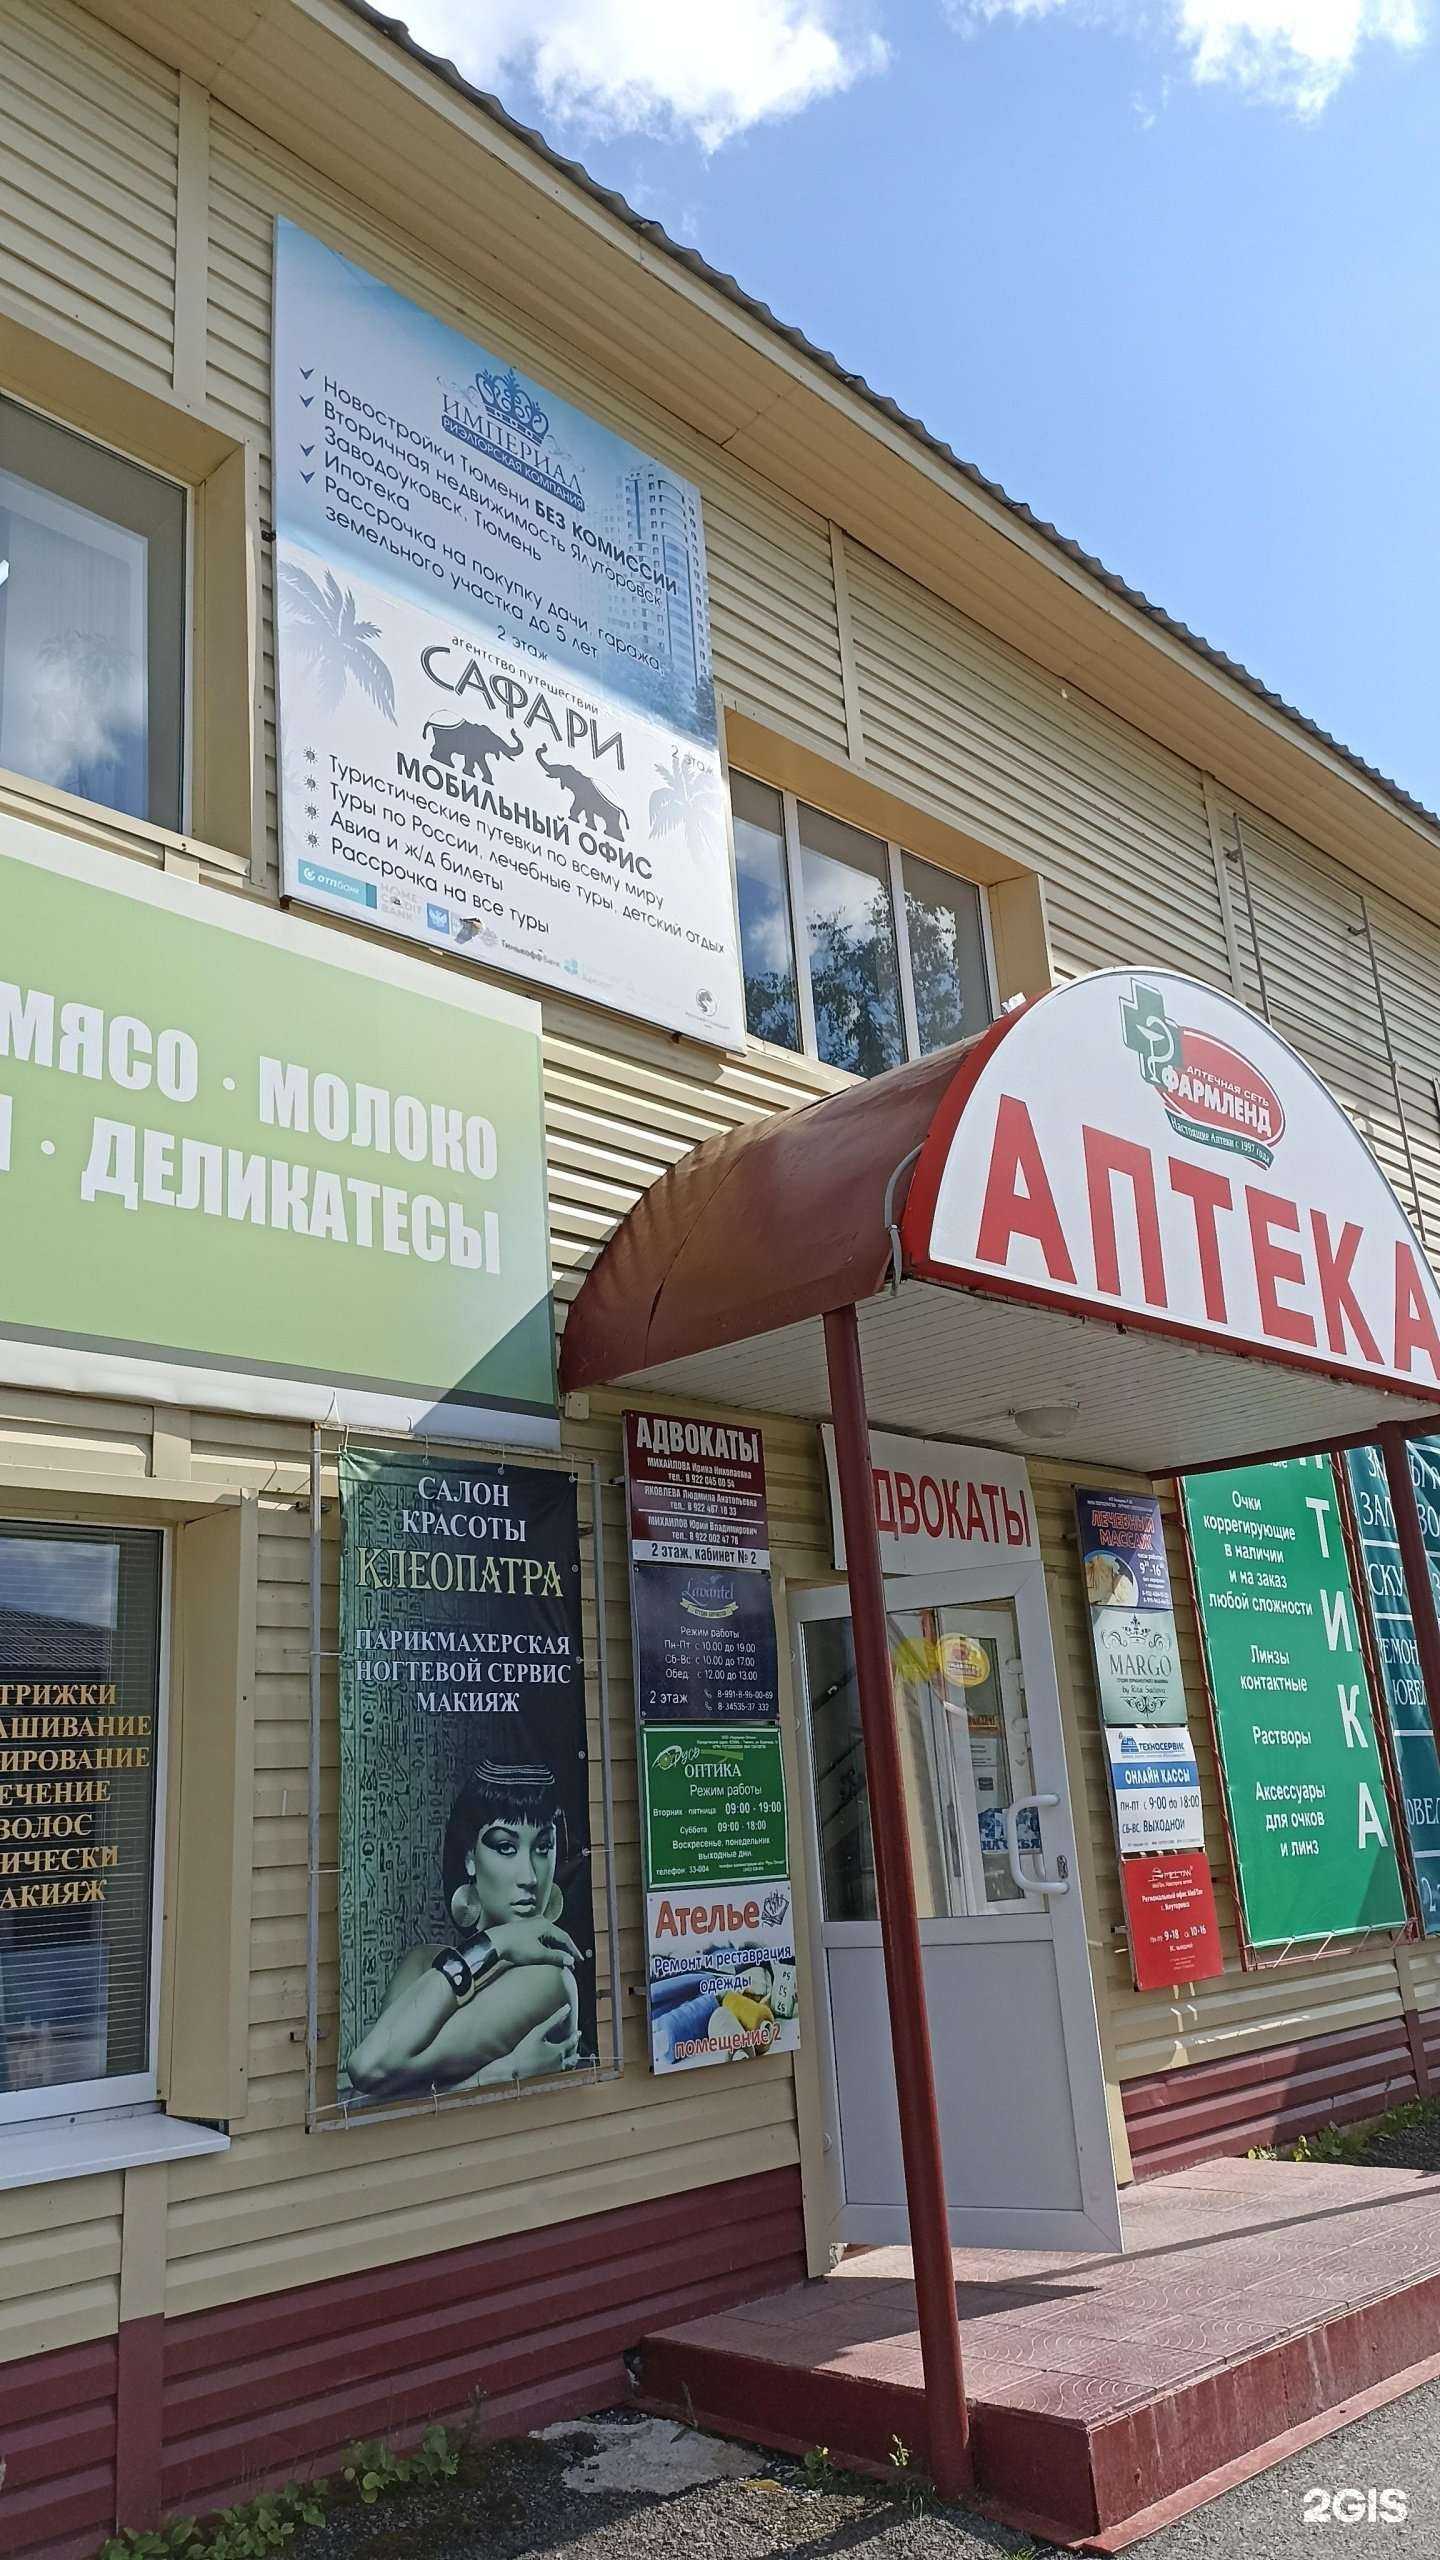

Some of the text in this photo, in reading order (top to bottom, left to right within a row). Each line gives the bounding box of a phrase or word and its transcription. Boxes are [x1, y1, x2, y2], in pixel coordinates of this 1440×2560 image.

[442, 393, 582, 495] ИМПЕРИАЛ
[443, 416, 584, 508] РИЭЛТОРСКАЯ КОМПАНИЯ
[324, 400, 430, 475] Вторичная
[436, 469, 566, 552] недвижимость
[324, 451, 410, 512] Ипотека
[324, 375, 678, 596] Новостройки Тюмени БЕЗ КОМИССИИ
[324, 425, 542, 561] Заводоуковск, Тюмень
[325, 476, 436, 551] Рассрочка
[443, 544, 466, 566] на
[472, 559, 542, 610] покупку
[325, 506, 598, 660] земельного участка до 5 лет
[451, 635, 516, 675] агентство
[497, 624, 549, 662] 2 этаж
[420, 645, 625, 771] САФАРИ
[396, 751, 653, 880] МОБИЛЬНЫЙ ОФИС
[329, 754, 664, 911] Туристические путевки по всему миру
[330, 810, 503, 891] Авиа и ж/д билеты
[329, 781, 725, 954] Туры по России, лечебные туры, детский отдых
[331, 836, 549, 934] Рассрочка на все туры
[0, 980, 499, 1181] МЯСО МОЛОКО
[1187, 1064, 1270, 1107] АПТЕЧНАЯ СЕТЬ
[1161, 1064, 1272, 1138] ФАРМЛЕНД
[81, 1116, 501, 1275] ДЕЛИКАТЕСЫ
[974, 1092, 1440, 1383] АПТЕКА
[636, 1416, 760, 1464] АДВОКАТЫ
[418, 1476, 510, 1507] САЛОН
[1232, 1490, 1262, 1511] Очки
[872, 1468, 1031, 1548] ДВОКАТЫ
[1091, 1509, 1155, 1533] ЛЕЧЕБНЫЙ
[401, 1509, 527, 1542] КРАСОТЫ
[1203, 1514, 1296, 1541] коррегирующие
[1099, 1529, 1153, 1551] МАССАЖ
[1224, 1543, 1285, 1563] в наличии
[651, 1542, 659, 1557] 2
[694, 1546, 735, 1564] кабинет
[750, 1551, 757, 1565] 2
[355, 1547, 564, 1597] КЛЕОПАТРА
[1229, 1569, 1288, 1589] и на заказ
[1208, 1590, 1313, 1616] любой сложности
[354, 1629, 571, 1655] ПАРИКМАХЕРСКАЯ
[680, 1625, 740, 1639] Режим работы
[664, 1640, 691, 1649] Пн-Пт
[724, 1645, 735, 1653] до
[1250, 1644, 1290, 1665] Линзы
[1378, 1638, 1420, 1666] ЕМОН
[354, 1658, 571, 1684] НОГТЕВОЙ СЕРВИС
[664, 1654, 691, 1665] Сб-Вс
[724, 1659, 735, 1667] до
[1109, 1653, 1172, 1677] MARGO
[665, 1668, 689, 1680] Обед
[727, 1673, 737, 1681] до
[1240, 1675, 1308, 1692] контактные
[0, 1684, 117, 1706] ТРИЖКИ
[416, 1692, 520, 1713] МАКИЯЖ
[649, 1690, 689, 1704] 2 этаж
[1138, 1741, 1185, 1752] ТЕХНОСЕРВИС
[1252, 1725, 1312, 1749] Растворы
[0, 1747, 150, 1772] ИРОВАНИЕ
[684, 1763, 742, 1779] ОПТИКА
[1125, 1766, 1191, 1785] ОНЛАЙН КАССЫ
[0, 1780, 112, 1806] ЕЧЕНИЕ
[690, 1783, 762, 1797] Режим работы
[1148, 1796, 1167, 1810] 9:00
[1180, 1794, 1200, 1809] 18:00
[1256, 1781, 1326, 1804] Аксессуары
[653, 1808, 683, 1818] Вторник
[725, 1802, 750, 1815] 09:00
[758, 1801, 782, 1814] 19:00
[1265, 1811, 1325, 1832] для очков
[0, 1813, 93, 1840] ВОЛОС
[679, 1820, 767, 1836] Суббота 09:00 18:00
[1143, 1818, 1185, 1833] ВЫХОДНОЙ
[0, 1846, 119, 1874] ИЧЕСКИ
[698, 1851, 737, 1861] выходные
[1280, 1840, 1320, 1857] и линз
[0, 1879, 108, 1909] АКИЯЖ
[655, 1899, 761, 1939] Ателье
[654, 1945, 792, 1975] Ремонт и реставрация
[701, 1975, 752, 1995] одежды
[674, 2023, 782, 2059] помещение 2
